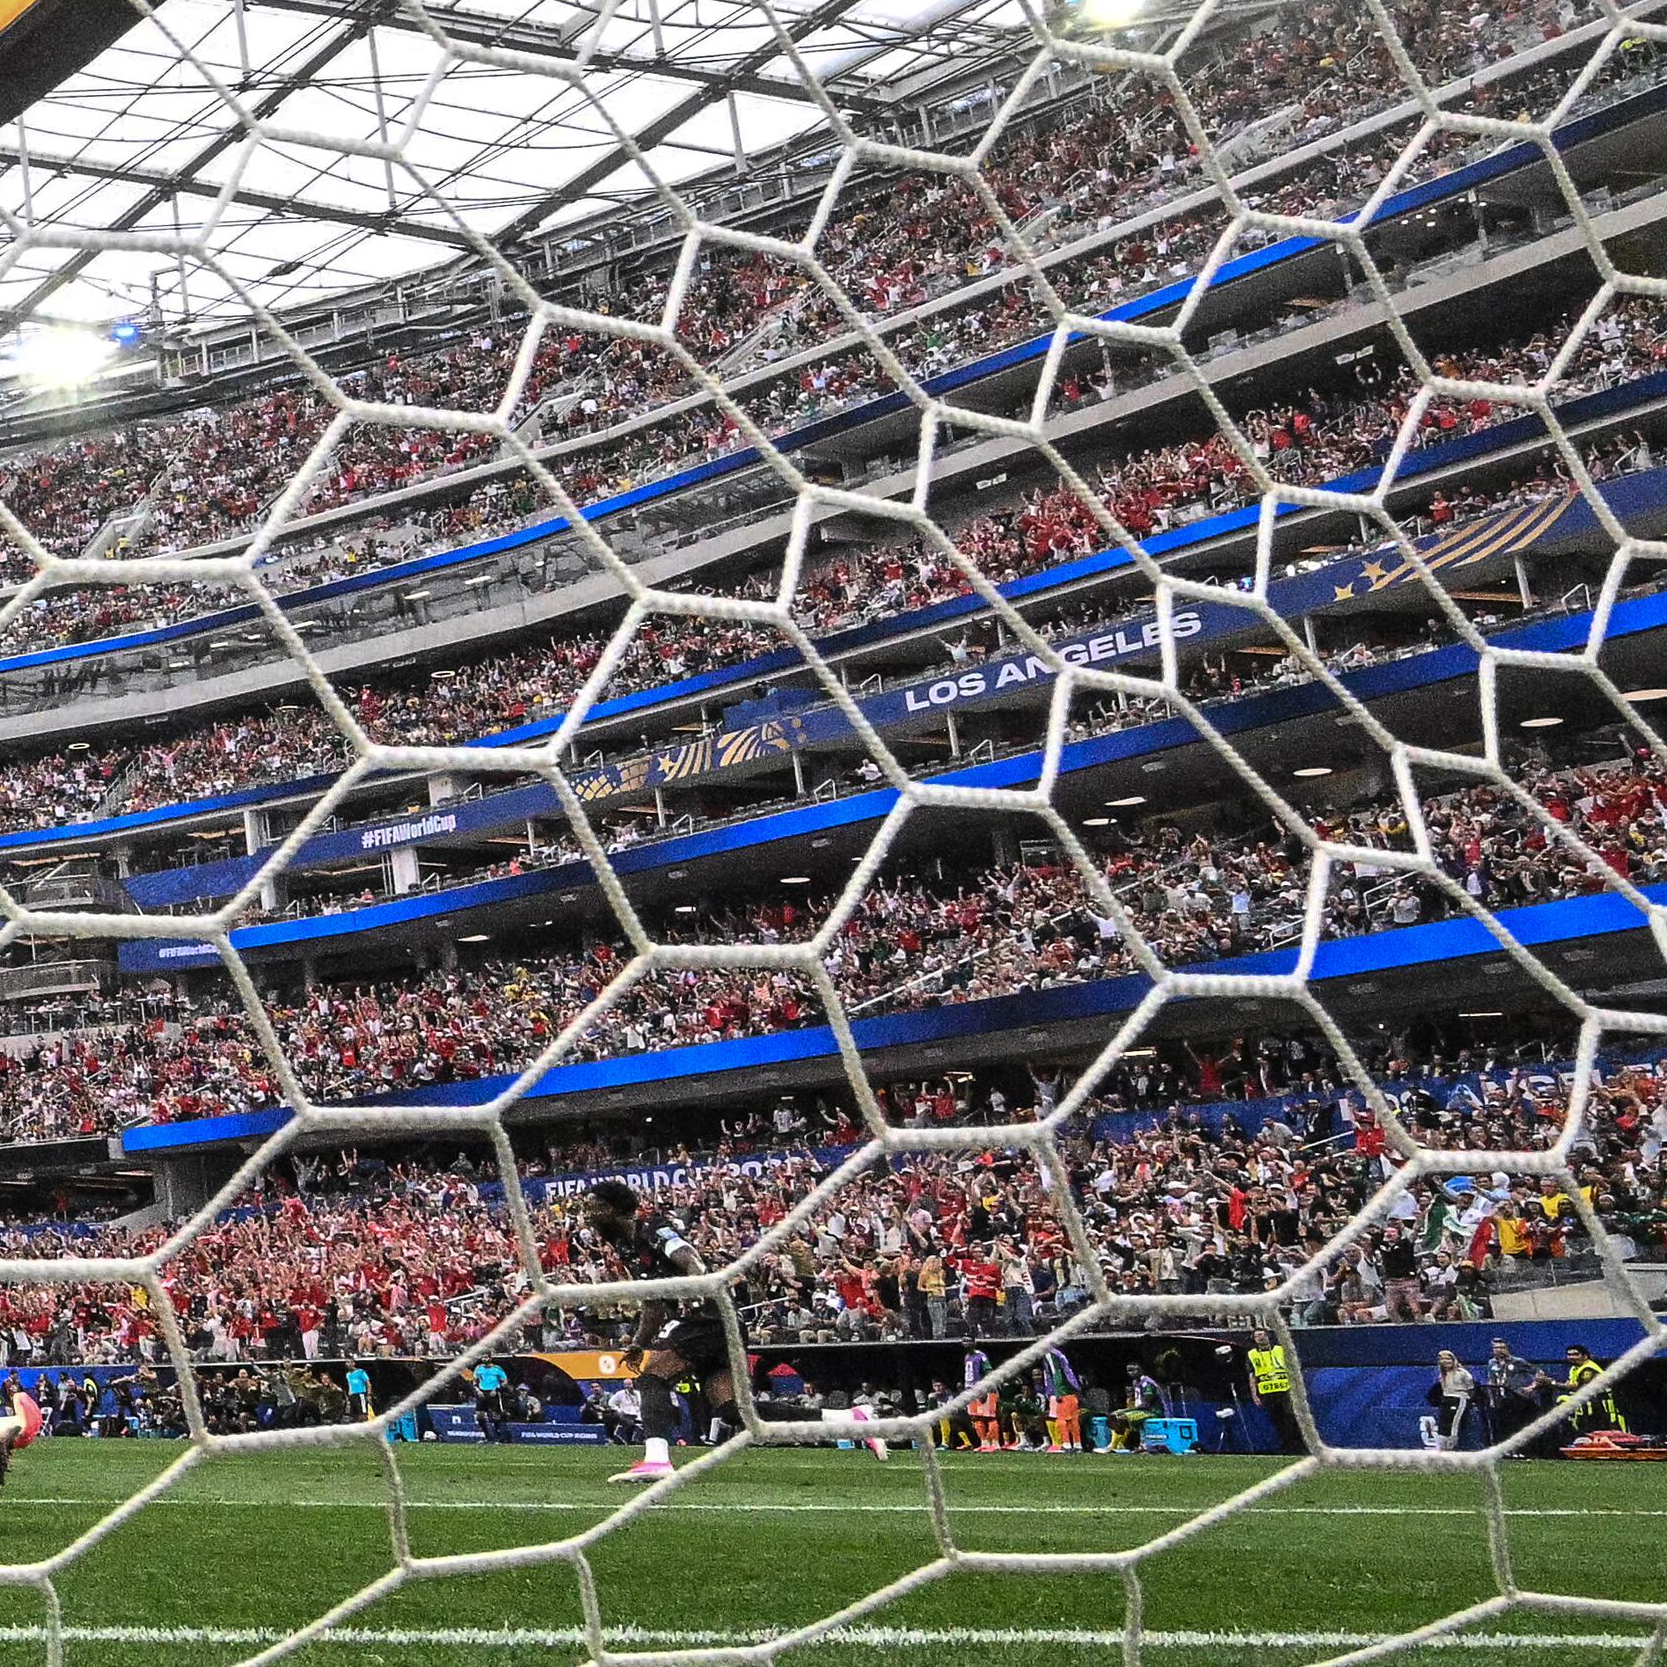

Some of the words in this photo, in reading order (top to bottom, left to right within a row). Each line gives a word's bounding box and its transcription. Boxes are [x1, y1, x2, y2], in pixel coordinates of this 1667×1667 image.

[905, 672, 988, 713] LOS
[994, 611, 1203, 690] ANGELES
[361, 814, 456, 849] #FIFAWorldCup
